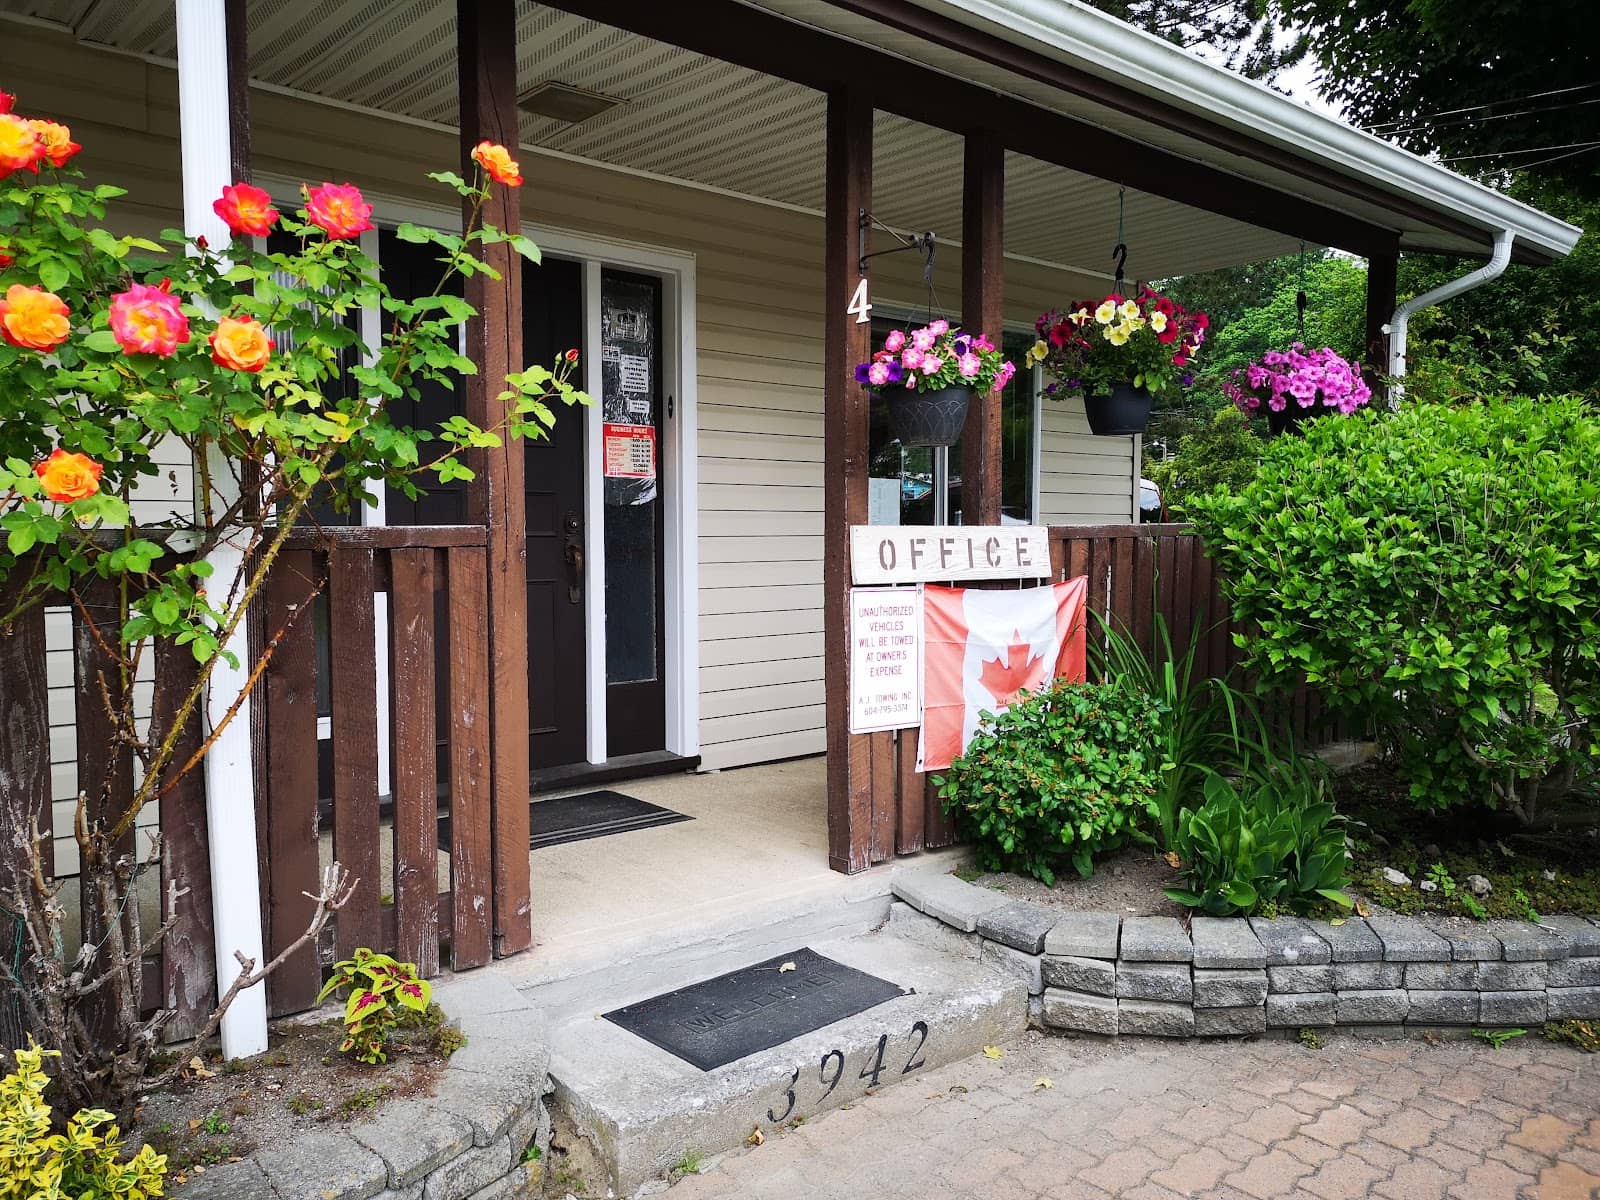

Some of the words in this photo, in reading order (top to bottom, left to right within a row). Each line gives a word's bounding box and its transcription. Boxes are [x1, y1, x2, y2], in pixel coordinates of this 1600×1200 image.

[847, 279, 872, 323] 4
[879, 537, 1031, 570] OFFICE
[858, 605, 914, 618] UNAUTHORIZED
[869, 621, 904, 632] VEHICLES
[858, 638, 876, 648] WILL
[878, 636, 888, 647] BE
[891, 635, 914, 646] TOWED
[866, 652, 874, 662] AT
[870, 665, 903, 678] EXPENSE
[875, 692, 898, 704] TOWING
[688, 974, 833, 1028] WELCOME
[767, 1021, 928, 1123] 3942
